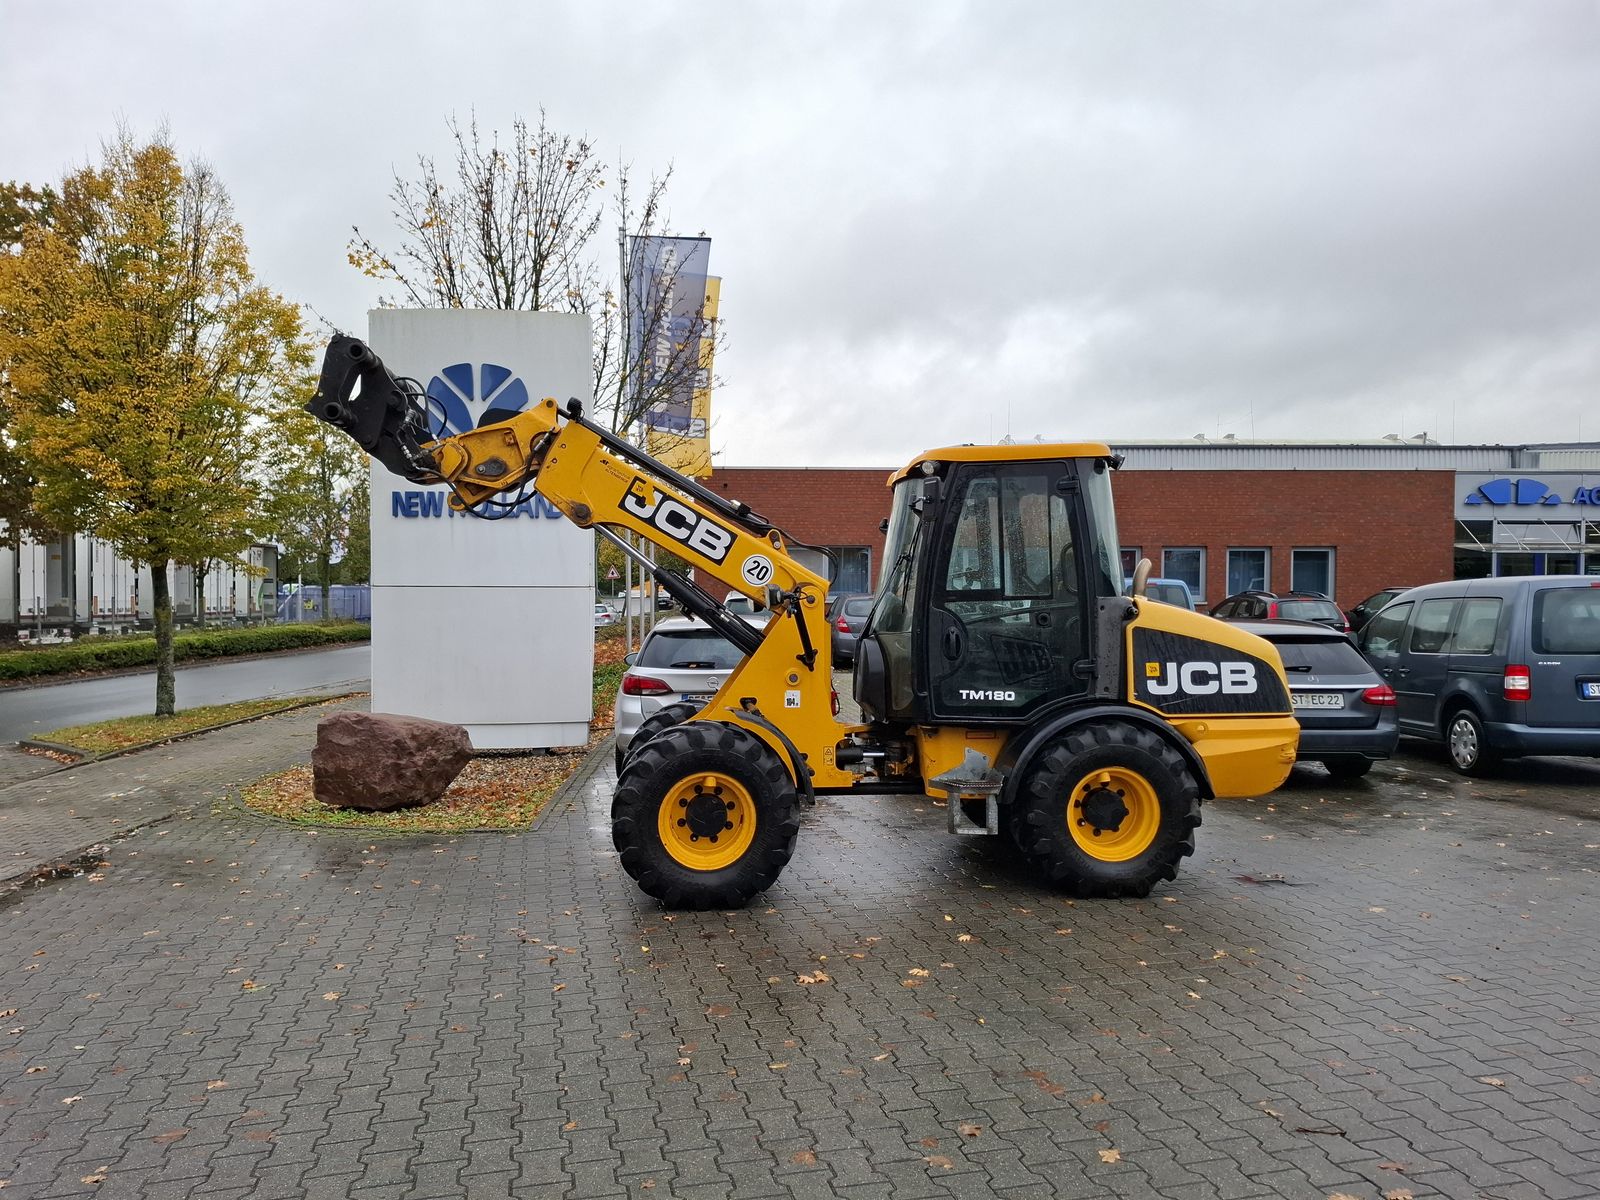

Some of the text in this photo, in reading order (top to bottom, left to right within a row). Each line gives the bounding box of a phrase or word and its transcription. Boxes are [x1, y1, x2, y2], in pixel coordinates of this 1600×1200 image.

[391, 491, 445, 518] NEW
[624, 490, 732, 560] JCB
[746, 560, 769, 581] 20
[1147, 661, 1258, 695] JCB
[959, 689, 1016, 701] TM180
[1292, 695, 1340, 705] ST EC 22
